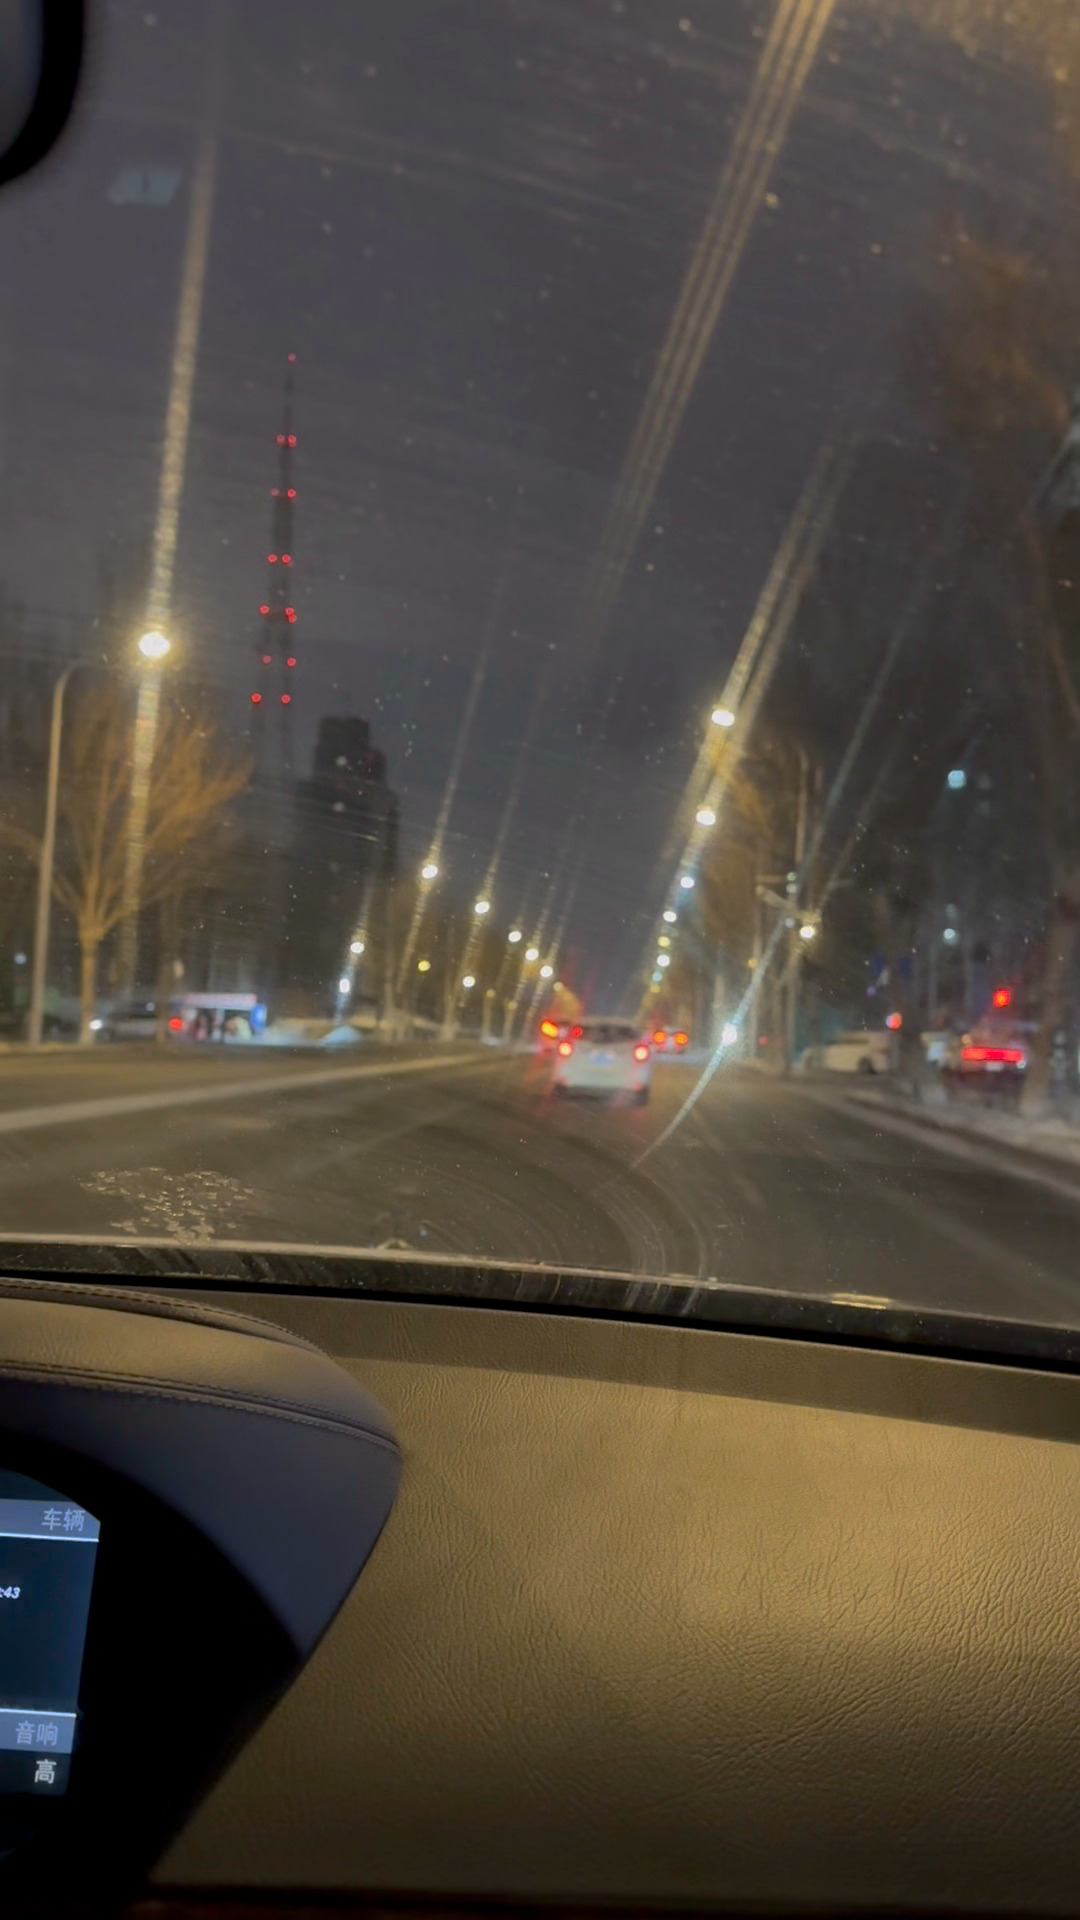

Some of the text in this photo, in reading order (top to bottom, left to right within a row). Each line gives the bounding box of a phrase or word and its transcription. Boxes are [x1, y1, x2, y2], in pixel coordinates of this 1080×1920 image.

[42, 1507, 85, 1531] 车辆
[0, 1586, 21, 1599] :43
[15, 1720, 59, 1745] 音响
[34, 1758, 57, 1784] 高
